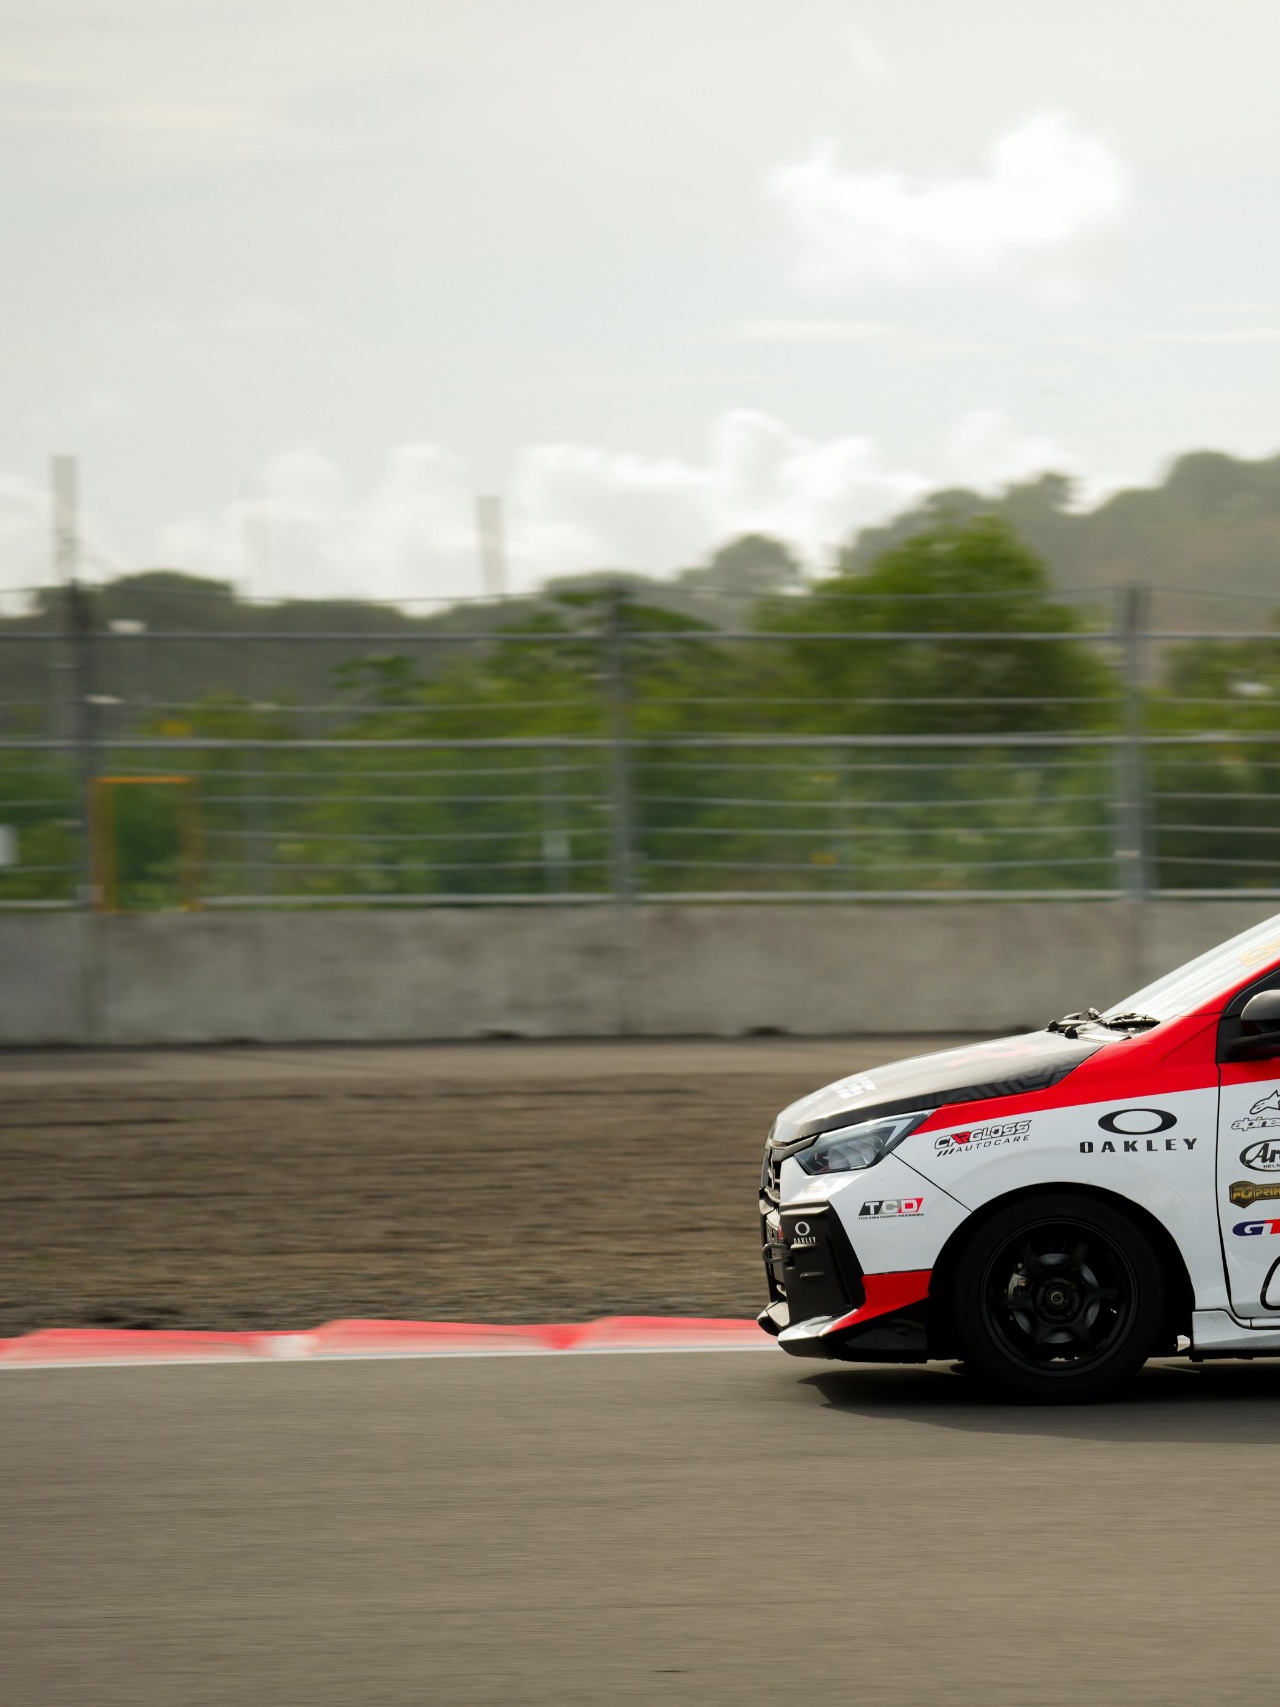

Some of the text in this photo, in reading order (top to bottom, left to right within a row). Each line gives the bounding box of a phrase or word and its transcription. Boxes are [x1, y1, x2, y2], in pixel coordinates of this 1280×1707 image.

[934, 1119, 1033, 1149] CARGLOSS
[955, 1134, 1031, 1154] AUTOCARE
[1080, 1137, 1198, 1154] OAKLEY
[864, 1199, 918, 1215] TCD
[793, 1236, 816, 1244] OAKLEY
